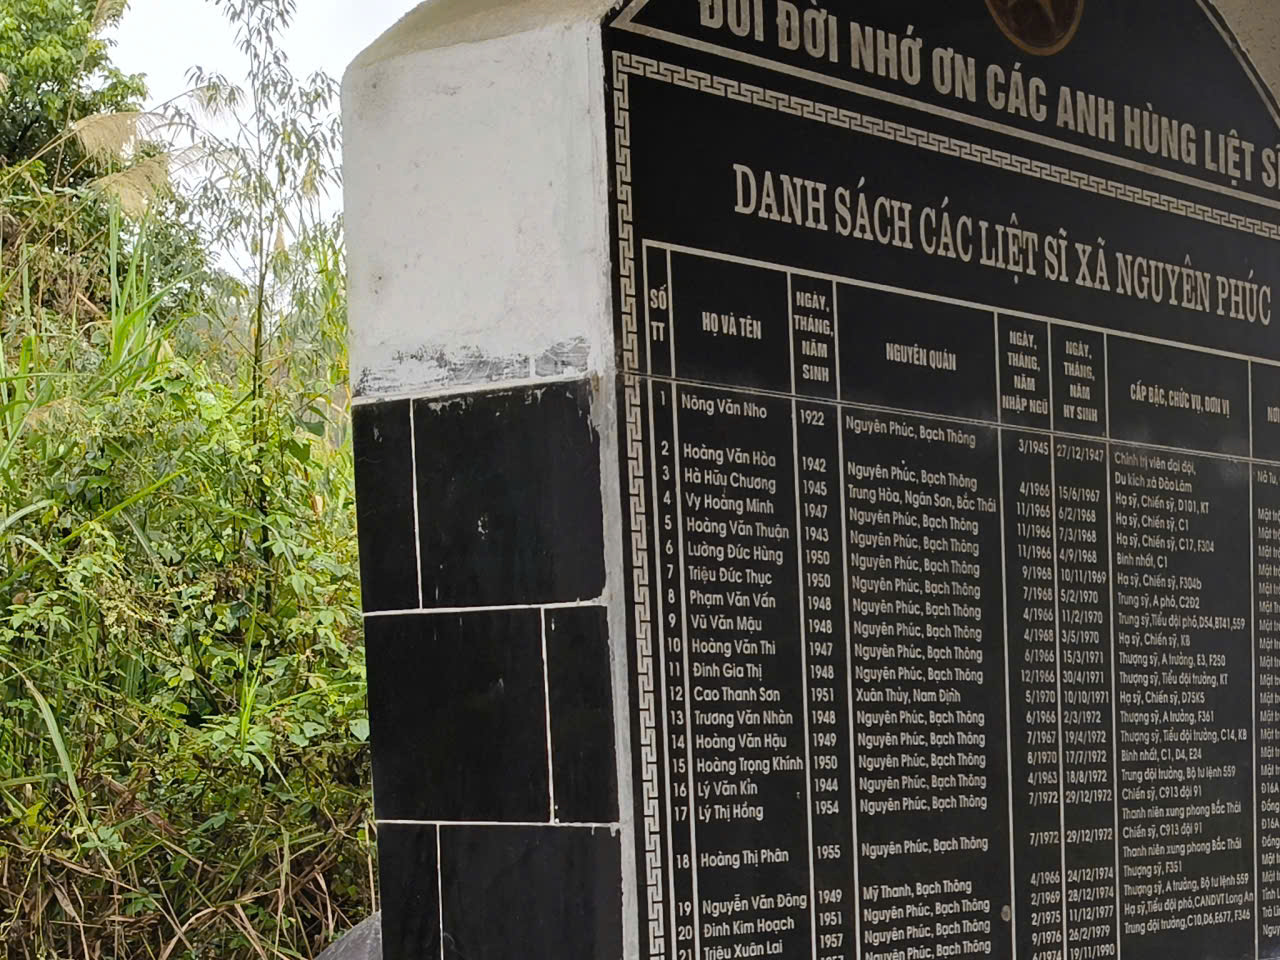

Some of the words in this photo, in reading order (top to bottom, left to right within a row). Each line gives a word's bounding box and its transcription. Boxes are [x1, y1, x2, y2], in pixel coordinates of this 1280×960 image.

[775, 0, 839, 64] ĐỜI
[849, 21, 923, 86] NHỚ
[931, 46, 977, 103] ƠN
[986, 61, 1048, 123] CÁC
[1056, 85, 1116, 143] ANH
[1123, 101, 1197, 166] HÙNG
[1203, 128, 1255, 187] LIỆT
[732, 163, 829, 231] DANH
[834, 176, 914, 250] SÁCH
[919, 195, 973, 263] CÁC
[978, 212, 1039, 285] LIỆT
[1043, 227, 1069, 283] SĨ
[1074, 236, 1111, 292] XÃ
[1114, 251, 1212, 313] NGUYÊN
[1215, 268, 1272, 326] PHÚC
[649, 283, 667, 311] SỐ
[795, 290, 830, 313] NGÀY,
[650, 320, 665, 342] TT
[701, 311, 719, 337] HỌ
[720, 311, 738, 336] VÀ
[738, 314, 762, 340] TÊN
[793, 313, 834, 337] THÁNG,
[801, 338, 828, 359] NĂM
[885, 342, 928, 367] NGUYÊN
[928, 348, 957, 371] QUÁN
[802, 363, 830, 383] SINH
[681, 393, 715, 416] Nông
[716, 398, 741, 416] Văn
[743, 401, 768, 419] Nho
[799, 408, 825, 426] 1922
[683, 442, 724, 466] Hoàng
[725, 447, 750, 465] Văn
[752, 450, 776, 467] Hòa
[684, 466, 702, 484] Hà
[729, 471, 776, 495] Chương
[802, 479, 828, 497] 1945
[686, 516, 727, 538] Hoàng
[728, 519, 753, 537] Văn
[754, 521, 790, 542] Thuận
[804, 525, 829, 543] 1943
[687, 565, 717, 585] Triệu
[718, 566, 743, 584] Đức
[806, 572, 831, 588] 1950
[690, 613, 708, 630] Vũ
[709, 613, 734, 630] Văn
[808, 618, 833, 634] 1948
[667, 636, 681, 653] 10
[691, 637, 732, 658] Hoàng
[733, 638, 758, 655] Văn
[1062, 670, 1104, 685] 30/4/1971
[669, 685, 684, 701] 12
[693, 685, 720, 701] Cao
[721, 686, 757, 702] Thanh
[758, 686, 781, 702] Sơn
[810, 687, 834, 702] 1951
[670, 709, 685, 725] 13
[694, 709, 735, 729] Trương
[736, 708, 761, 725] Văn
[695, 732, 736, 752] Hoàng
[737, 732, 762, 749] Văn
[763, 732, 787, 751] Hậu
[812, 732, 837, 747] 1949
[672, 758, 686, 774] 15
[696, 756, 737, 776] Hoàng
[738, 756, 771, 775] Trọng
[813, 754, 838, 770] 1950
[858, 753, 900, 772] Nguyên
[900, 752, 930, 769] Phúc,
[930, 752, 956, 770] Bạch
[956, 752, 986, 769] Thông
[1029, 830, 1060, 847] 7/1972
[676, 853, 690, 869] 18
[700, 850, 741, 869] Hoàng
[741, 849, 759, 868] Thị
[816, 844, 841, 860] 1955
[817, 888, 843, 904] 1949
[862, 884, 879, 903] Mỹ
[879, 883, 915, 899] Thanh,
[915, 880, 942, 898] Bạch
[942, 878, 973, 895] Thông
[677, 900, 692, 917] 19
[702, 893, 749, 918] Nguyễn
[750, 893, 775, 910] Văn
[776, 892, 808, 910] Đông
[703, 921, 731, 938] Đinh
[732, 919, 755, 935] Kim
[756, 915, 795, 935] Hoạch
[818, 910, 842, 927] 1951
[1030, 909, 1061, 927] 2/1975
[677, 924, 693, 941] 20
[1031, 929, 1062, 947] 9/1976
[1068, 924, 1111, 942] 26/2/1979
[733, 941, 765, 959] Xuân
[766, 938, 783, 955] Lai
